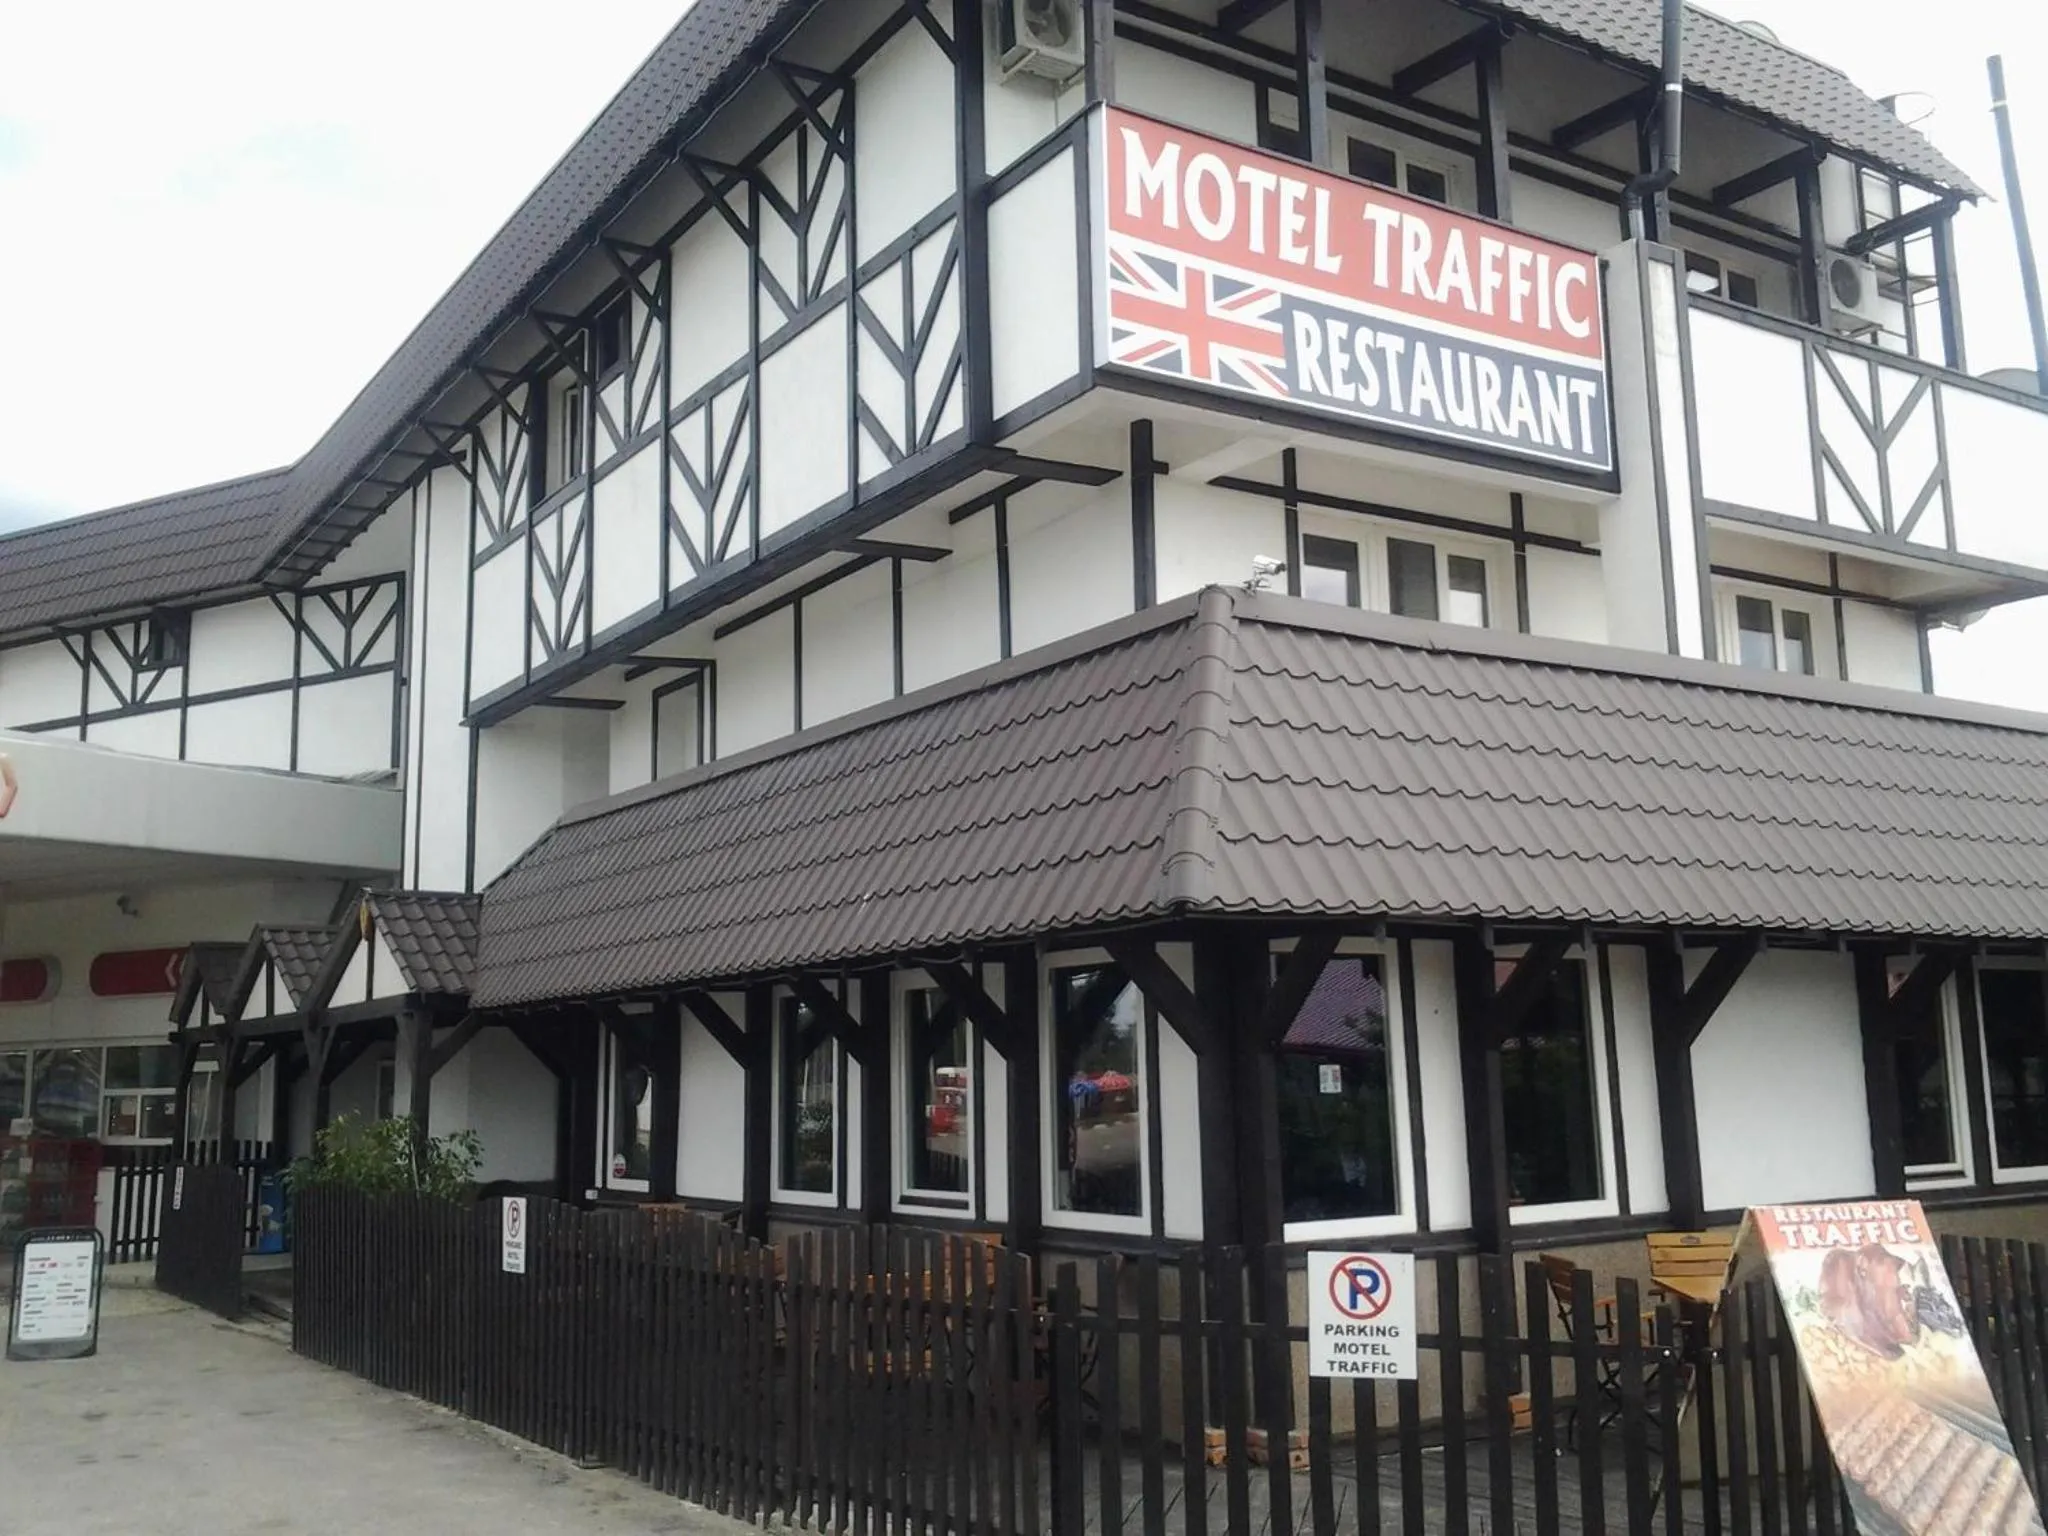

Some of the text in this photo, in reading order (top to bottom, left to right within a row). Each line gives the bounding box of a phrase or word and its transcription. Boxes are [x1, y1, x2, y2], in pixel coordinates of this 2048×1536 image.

[1121, 128, 1591, 338] MOTEL TRAFFIC
[1292, 310, 1598, 454] RESTAURANT
[1773, 1203, 1909, 1223] RESTAURANT
[1779, 1219, 1921, 1249] TRAFFIC
[1348, 1268, 1380, 1310] P
[1324, 1324, 1400, 1338] PARKING
[1333, 1342, 1391, 1356] MOTEL
[1327, 1360, 1398, 1374] TRAFFIC
